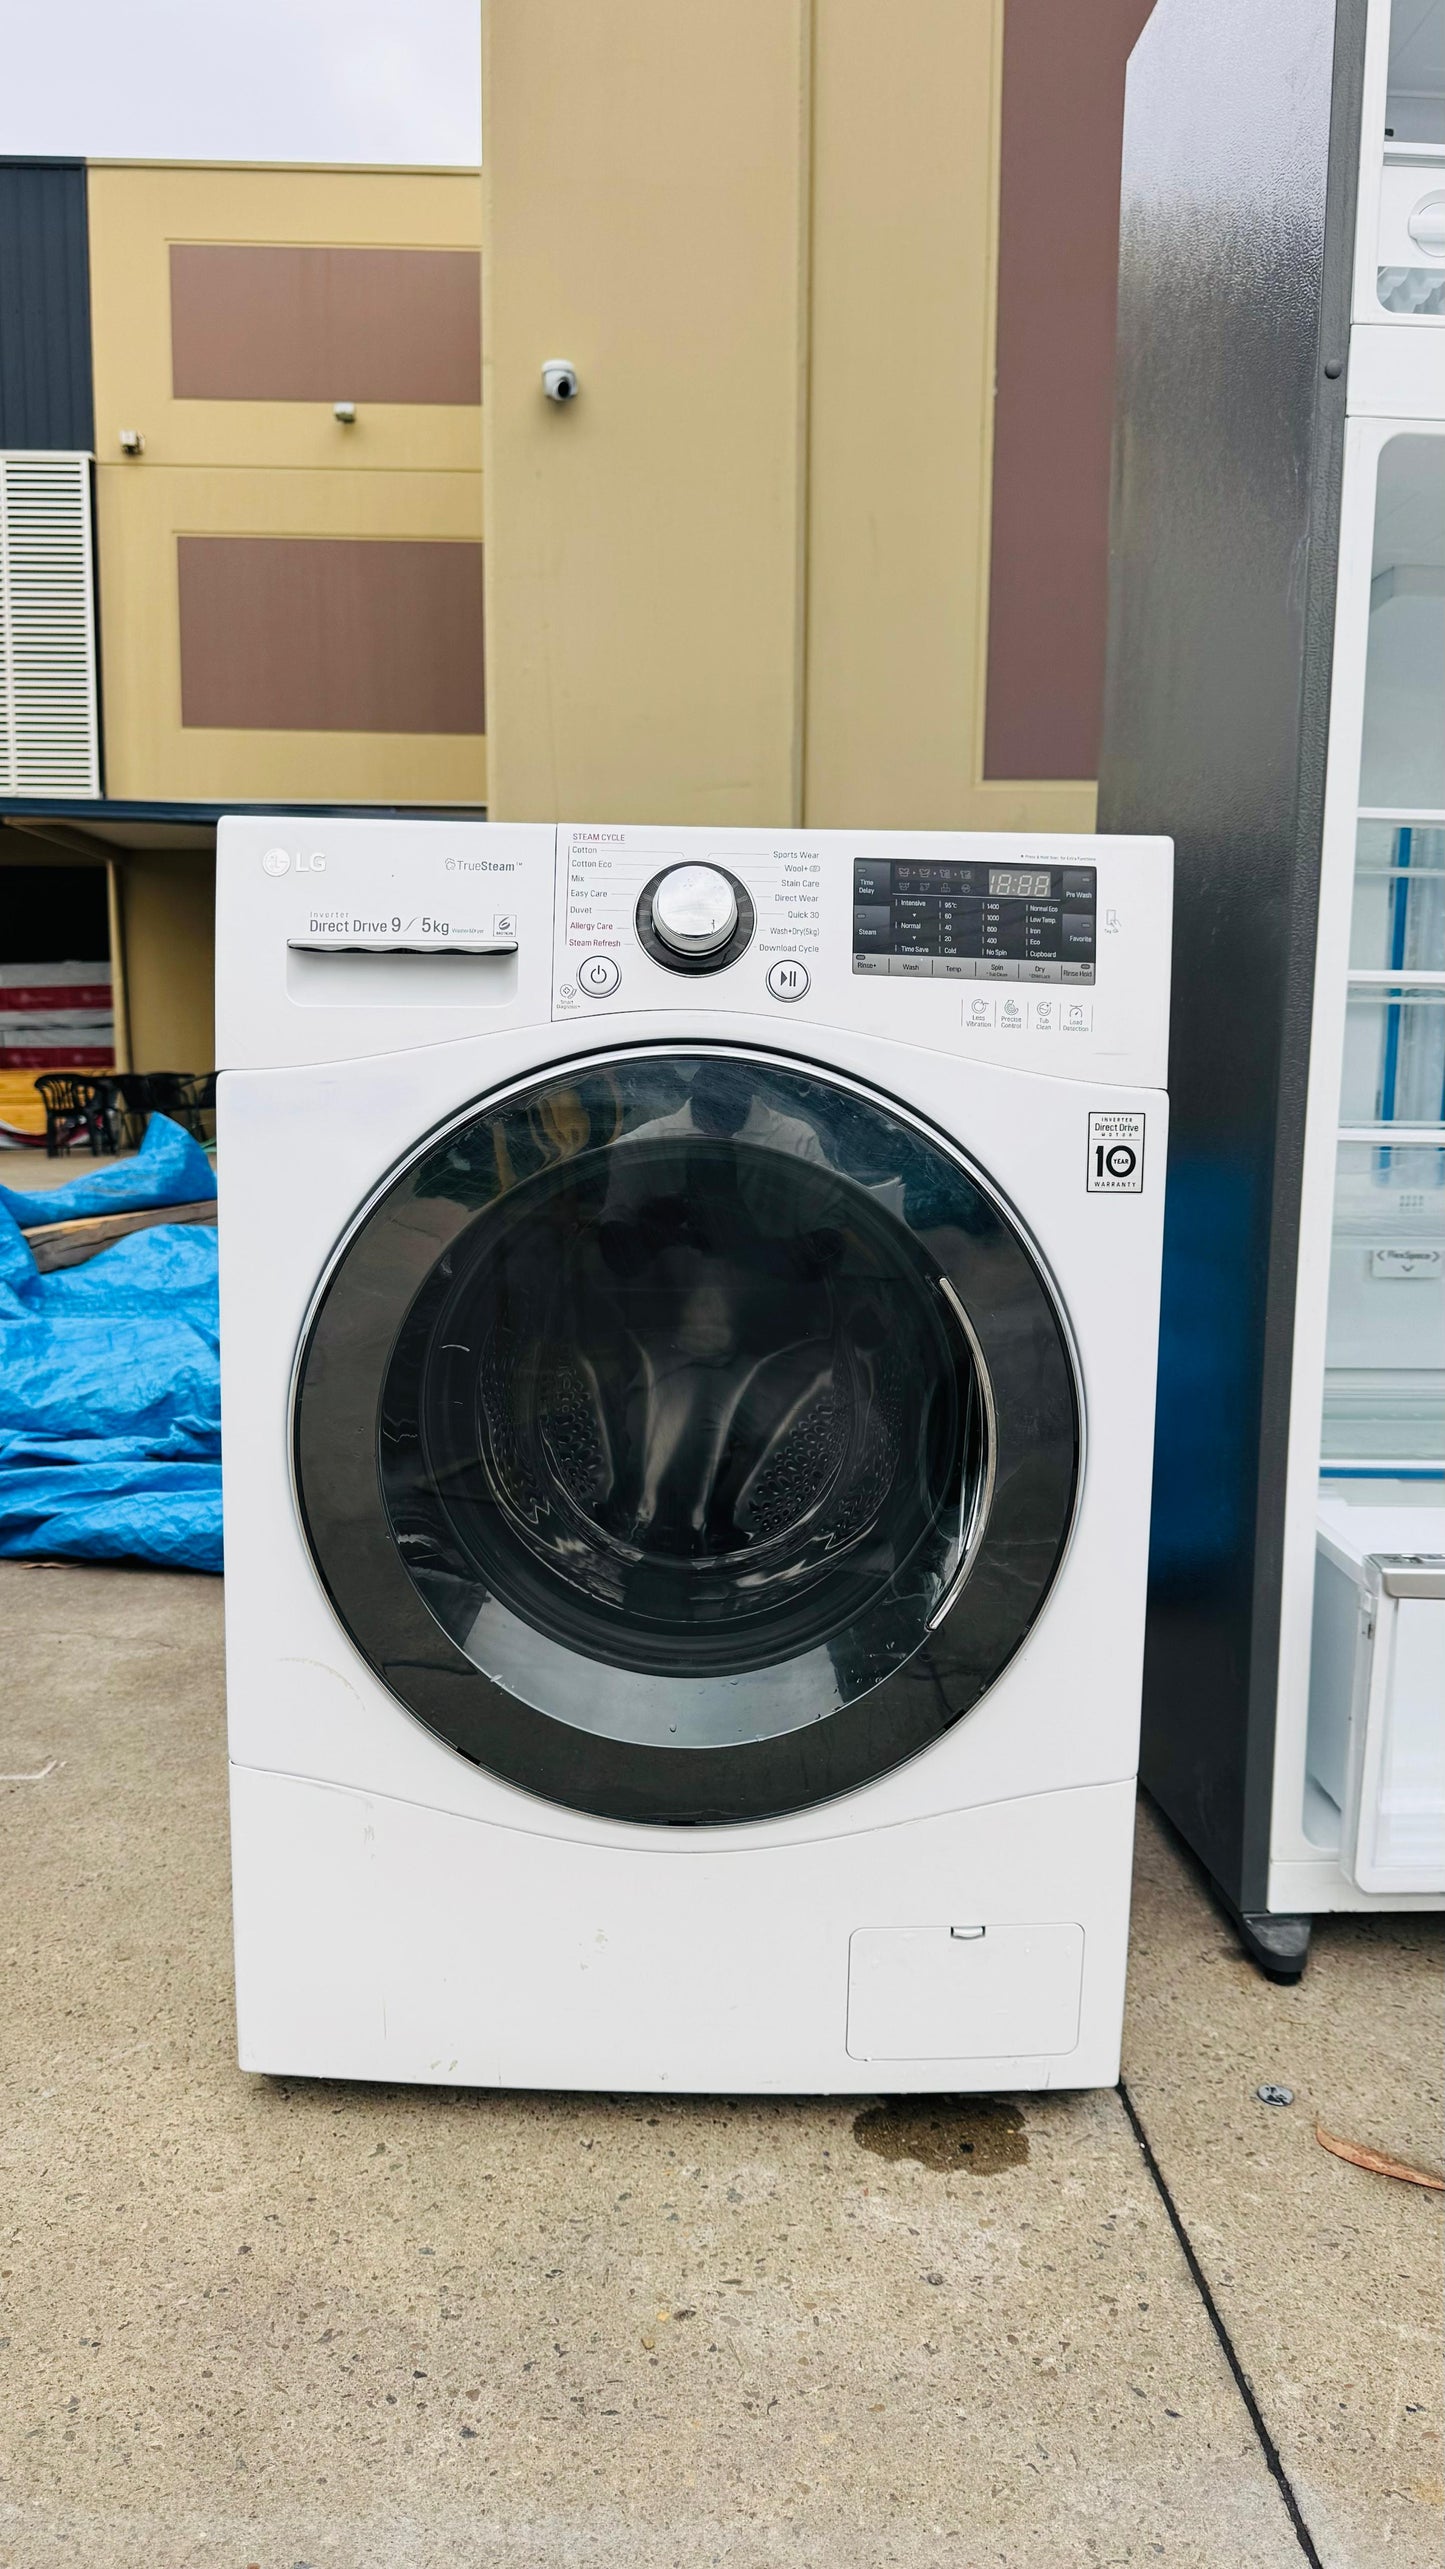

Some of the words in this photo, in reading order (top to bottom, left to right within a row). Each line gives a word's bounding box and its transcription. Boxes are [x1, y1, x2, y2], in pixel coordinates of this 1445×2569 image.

[573, 833, 600, 841] STEAM
[572, 846, 598, 854] Cotton
[773, 850, 798, 860] Sports
[799, 851, 820, 859] Wear
[295, 852, 327, 872] LG
[571, 860, 597, 869] Cotton
[781, 879, 801, 887] Stain
[802, 880, 820, 888] Care
[570, 890, 588, 898] Easy
[590, 890, 607, 898] Care
[858, 886, 875, 895] Delay
[774, 894, 797, 902] Direct
[798, 895, 819, 903] Wear
[1065, 891, 1076, 899] Pre
[1076, 891, 1093, 899] Wash
[570, 906, 592, 914] Duvet
[1029, 904, 1049, 912] Normal
[1048, 905, 1059, 913] Eco
[787, 910, 808, 919] Quick
[810, 911, 820, 919] 30
[1029, 916, 1041, 924] Low
[309, 919, 350, 933] Direct
[352, 920, 388, 933] Drive
[570, 922, 595, 931] Allergy
[597, 922, 613, 930] Care
[901, 921, 921, 929] Normal
[944, 923, 952, 931] 40
[770, 927, 820, 937] Wash+Dry(5kg)
[858, 928, 877, 936] Steam
[1029, 927, 1041, 935] Iron
[944, 934, 952, 942] 20
[1029, 938, 1041, 946] Eco
[1069, 935, 1093, 943] Favorite
[569, 939, 591, 947] Steam
[593, 939, 621, 947] Refresh
[759, 943, 797, 952] Download
[798, 945, 820, 954] Cycle
[901, 945, 914, 953] Time
[914, 945, 929, 953] Save
[944, 946, 957, 954] Cold
[986, 948, 995, 956] No
[995, 948, 1008, 957] Spin
[1029, 950, 1057, 959] Cupboard
[902, 963, 920, 971] Wash
[946, 966, 962, 974] Temp
[990, 963, 1004, 971] Spin
[1034, 965, 1046, 974] Dry
[1063, 969, 1079, 977] Rinse
[1079, 970, 1093, 978] Hold
[1001, 1015, 1022, 1023] Precise
[966, 1020, 992, 1028] Vibration
[1062, 1024, 1089, 1032] Detection
[1094, 1122, 1118, 1132] Direct
[1119, 1123, 1139, 1132] Drive
[1095, 1144, 1137, 1178] 10
